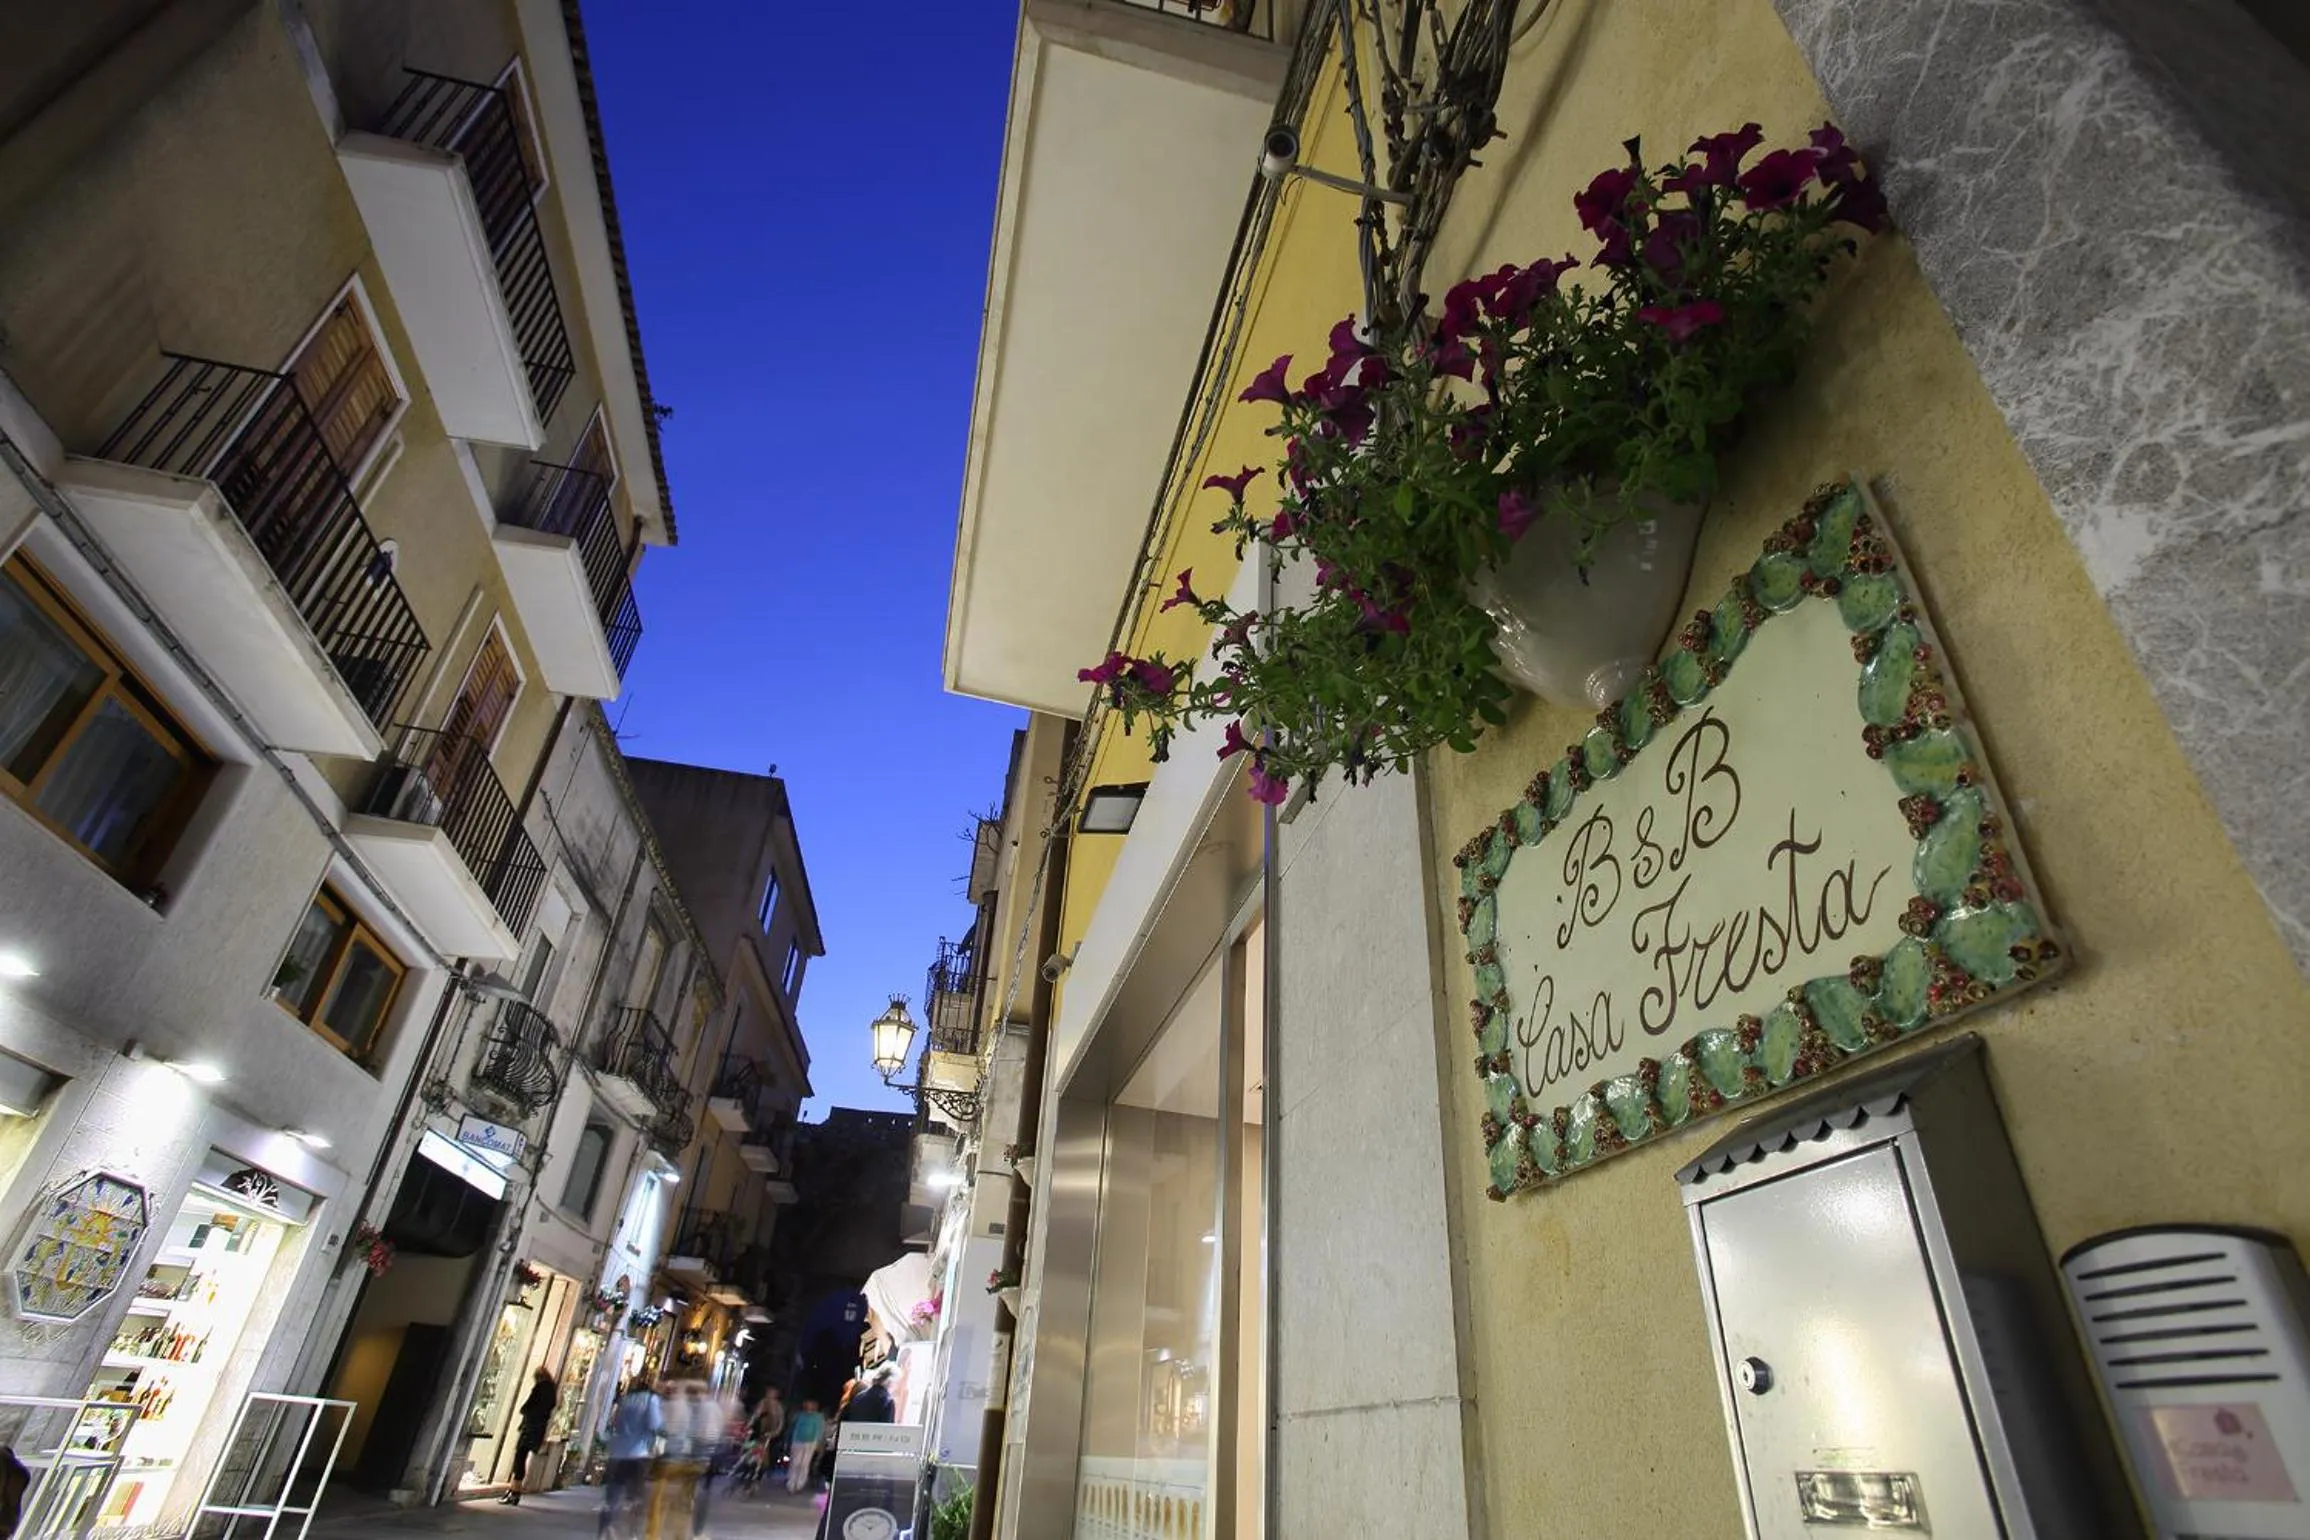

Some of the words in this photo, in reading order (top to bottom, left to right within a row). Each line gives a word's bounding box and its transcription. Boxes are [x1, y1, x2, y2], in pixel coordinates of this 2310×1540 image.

[1517, 974, 1624, 1098] Casa
[1632, 807, 1892, 1036] Fresta
[462, 1131, 512, 1152] BANCOMAT
